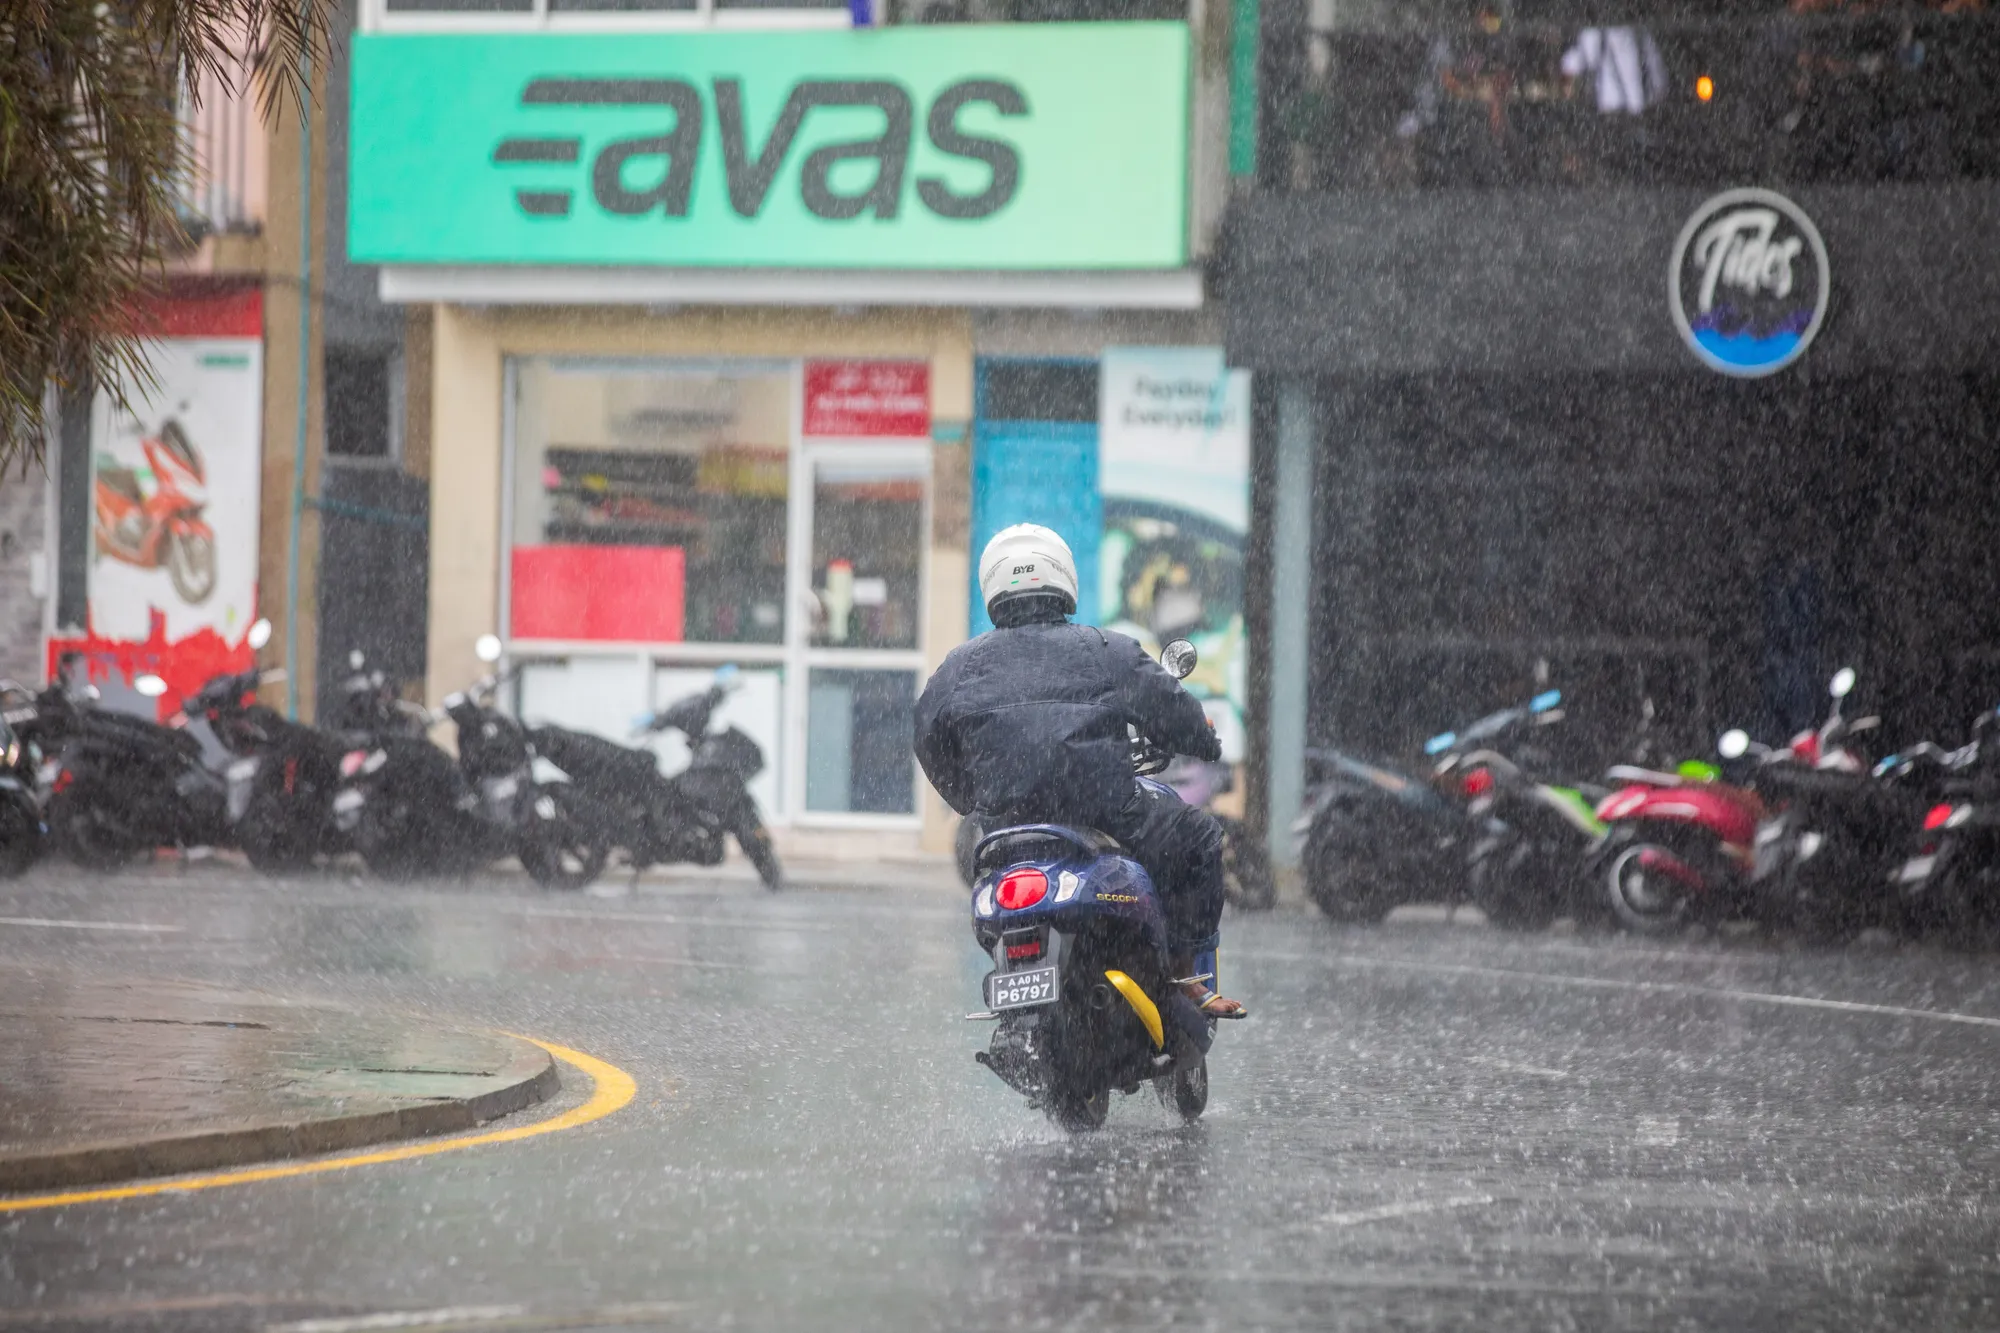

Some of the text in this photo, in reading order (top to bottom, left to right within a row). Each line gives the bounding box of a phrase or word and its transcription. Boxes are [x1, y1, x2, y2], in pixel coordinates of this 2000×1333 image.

[492, 77, 1031, 220] avas
[1694, 208, 1802, 314] Tides
[1012, 564, 1035, 575] BYB
[1096, 893, 1138, 903] SCOOPY
[997, 983, 1050, 1005] P6797
